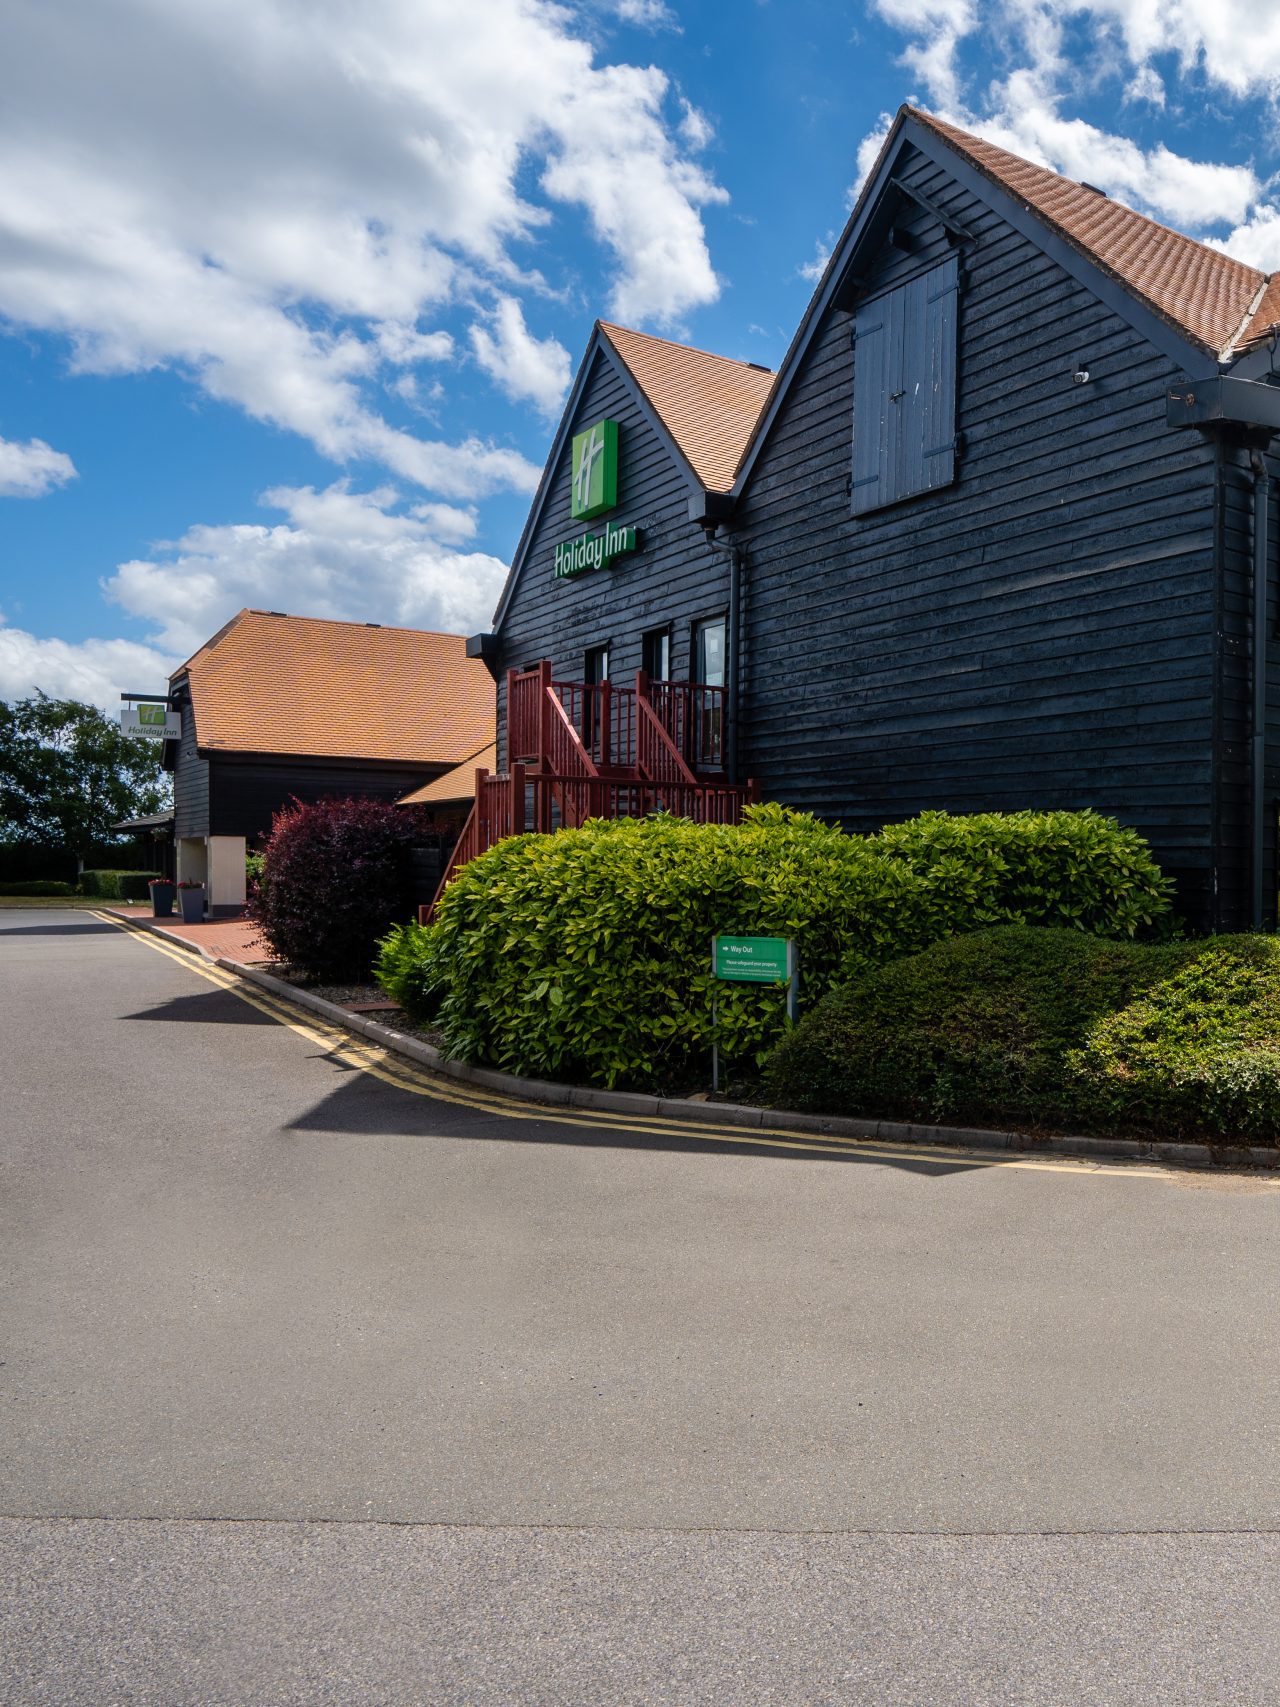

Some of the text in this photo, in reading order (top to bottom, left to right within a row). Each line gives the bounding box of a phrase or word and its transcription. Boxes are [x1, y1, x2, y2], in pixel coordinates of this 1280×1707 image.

[554, 522, 627, 578] Holiday Inn
[128, 726, 177, 736] Holiday Inn
[731, 946, 742, 954] Way
